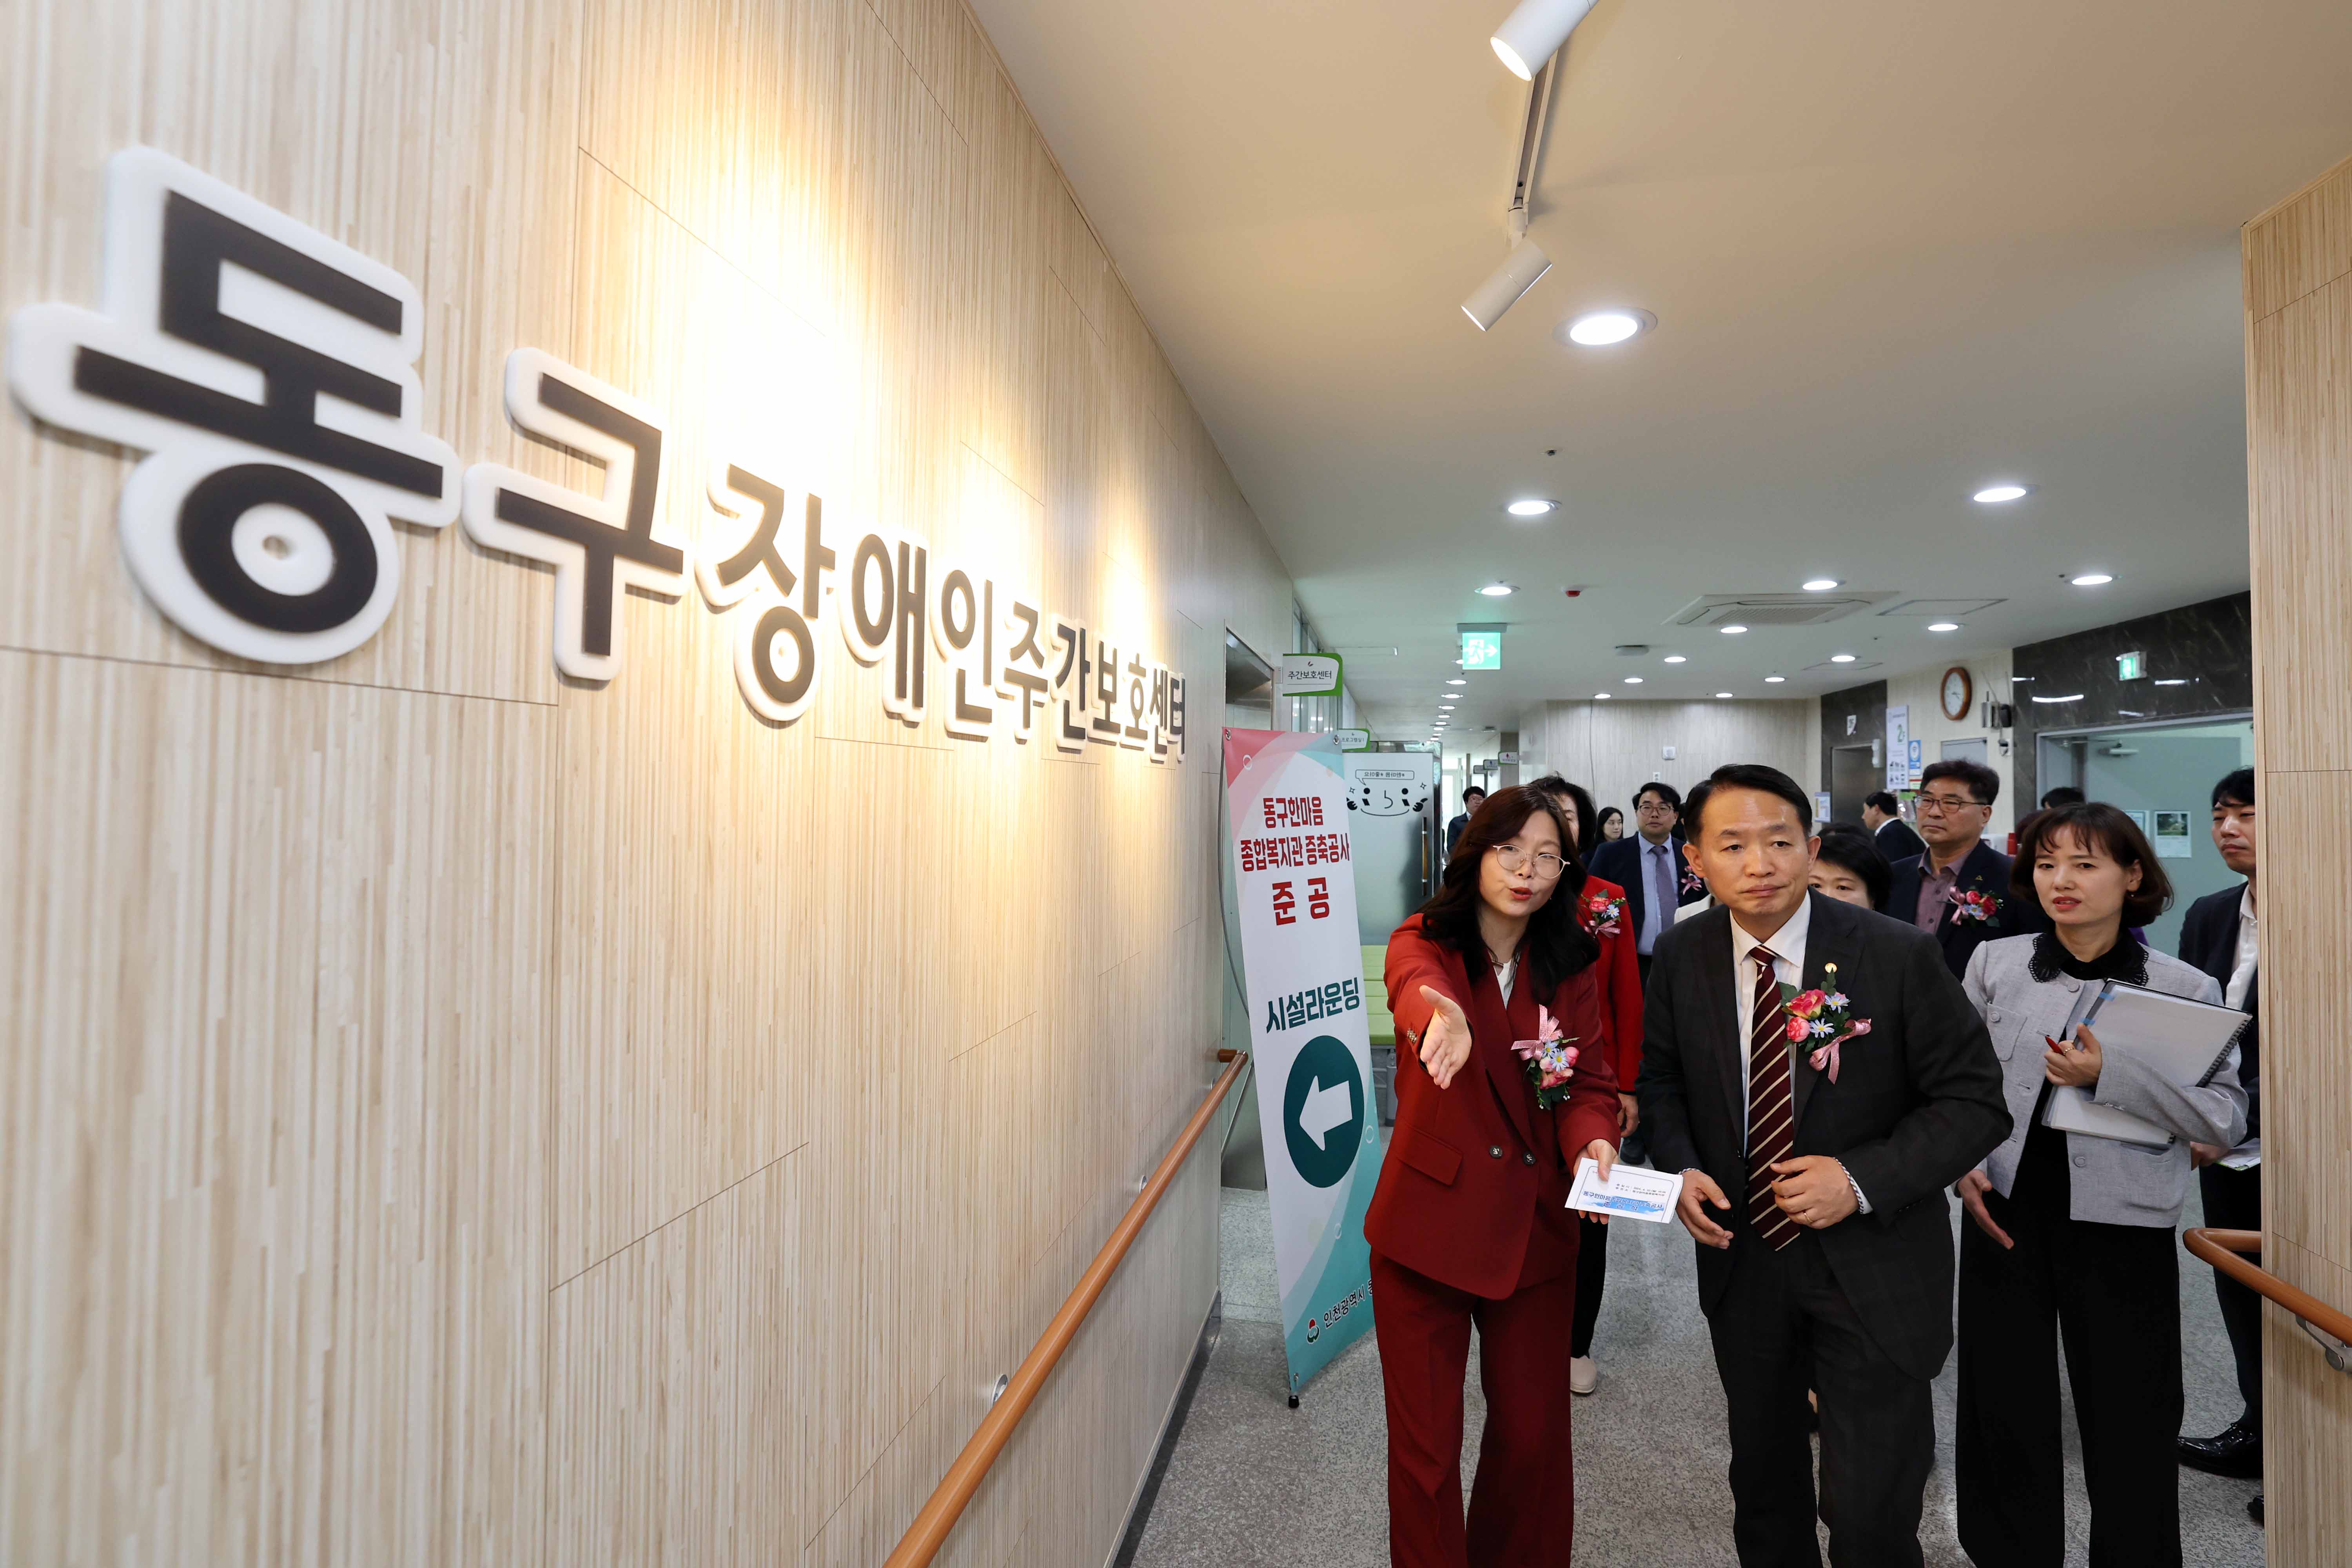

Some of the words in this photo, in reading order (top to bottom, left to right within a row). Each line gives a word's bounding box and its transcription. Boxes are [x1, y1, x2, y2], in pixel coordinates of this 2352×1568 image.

[1288, 670, 1332, 680] 주간보호센터
[1263, 796, 1323, 828] 동구한마음
[1240, 836, 1304, 872] 종합복지관
[1305, 833, 1350, 865] 증축공사
[1266, 977, 1360, 1034] 시설라운딩
[1324, 1285, 1365, 1328] 인천광역시
